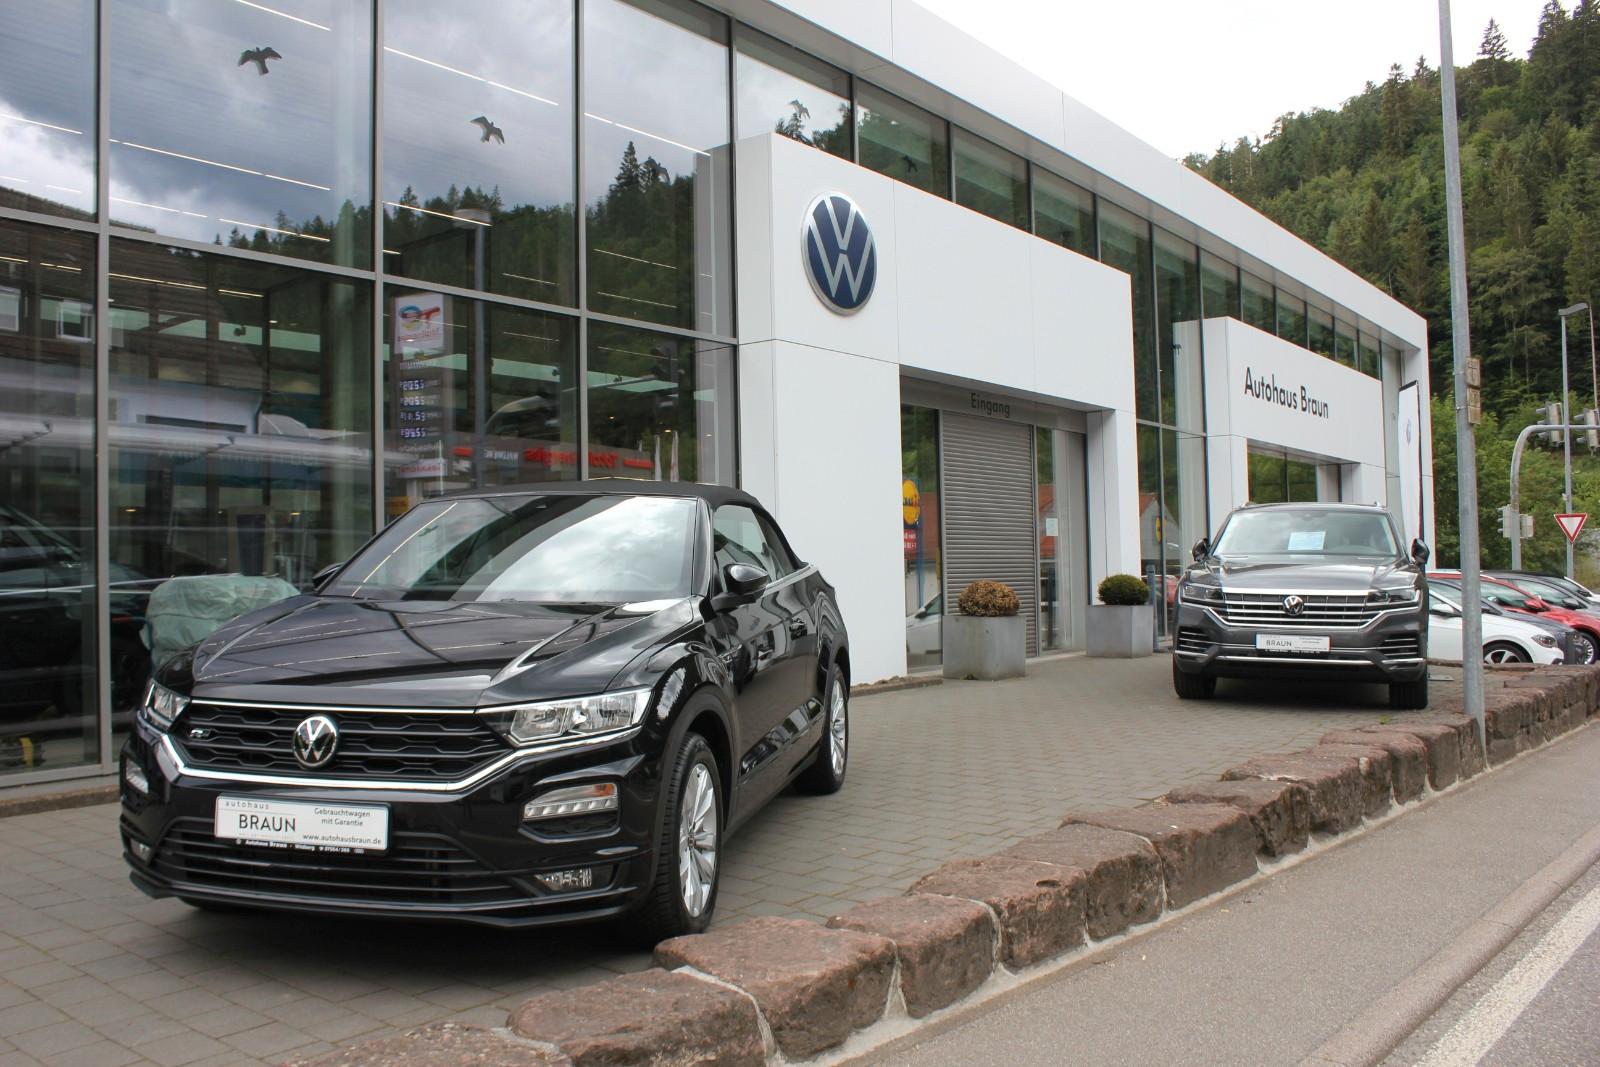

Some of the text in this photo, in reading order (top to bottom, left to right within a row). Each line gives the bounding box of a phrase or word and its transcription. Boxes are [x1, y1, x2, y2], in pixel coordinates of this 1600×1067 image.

[1244, 366, 1329, 419] Autohaus Braun
[970, 392, 1010, 418] Eingang
[1266, 639, 1292, 647] BRAUN
[225, 800, 269, 810] autohaus
[314, 807, 371, 818] Gebrauchtwagen
[239, 813, 296, 832] BRAUN
[321, 817, 364, 827] mit Garantie
[302, 834, 382, 845] www.autohausbraun.de
